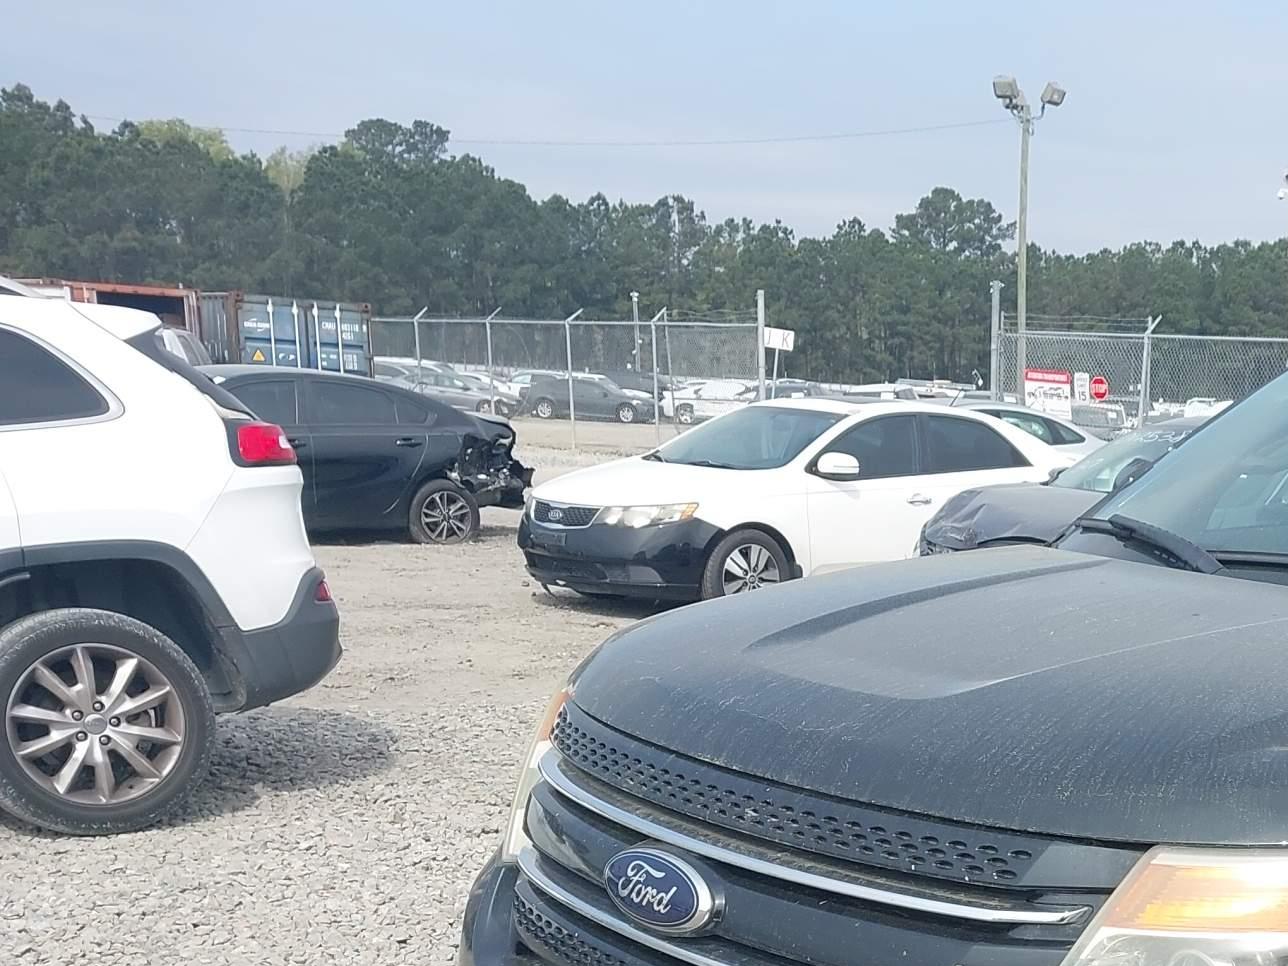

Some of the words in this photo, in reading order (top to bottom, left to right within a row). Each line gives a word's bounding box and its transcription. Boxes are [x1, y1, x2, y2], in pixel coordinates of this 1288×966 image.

[782, 331, 790, 348] K
[1091, 384, 1106, 394] STOP
[1078, 391, 1087, 401] 15
[617, 860, 678, 914] Ford
